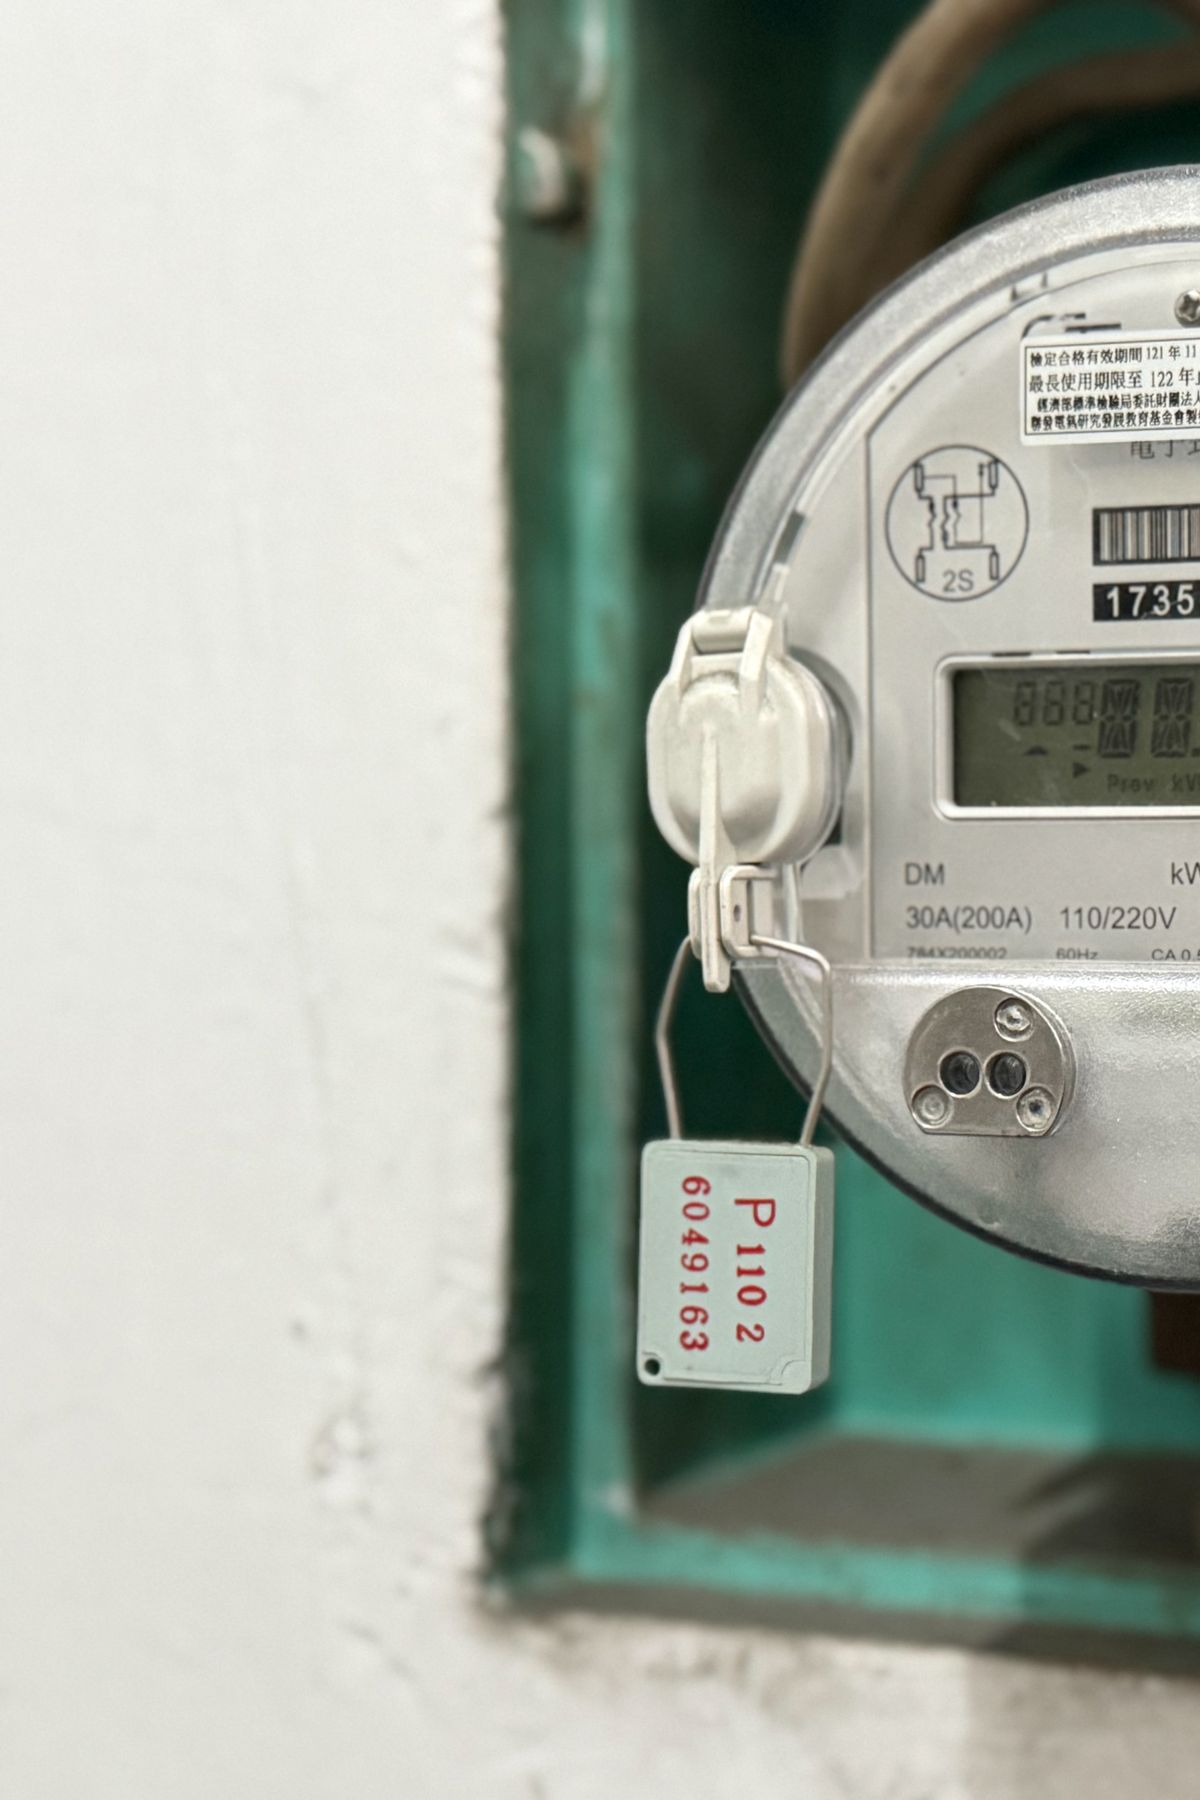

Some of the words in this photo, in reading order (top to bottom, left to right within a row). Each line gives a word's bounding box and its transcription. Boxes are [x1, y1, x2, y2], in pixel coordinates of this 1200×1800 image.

[942, 569, 975, 592] 2S
[904, 863, 946, 885] DM
[905, 905, 1033, 935] 30A(200A)
[1059, 906, 1177, 930] 110/220V
[1055, 947, 1099, 961] 60Hz
[679, 1175, 711, 1351] 6049163
